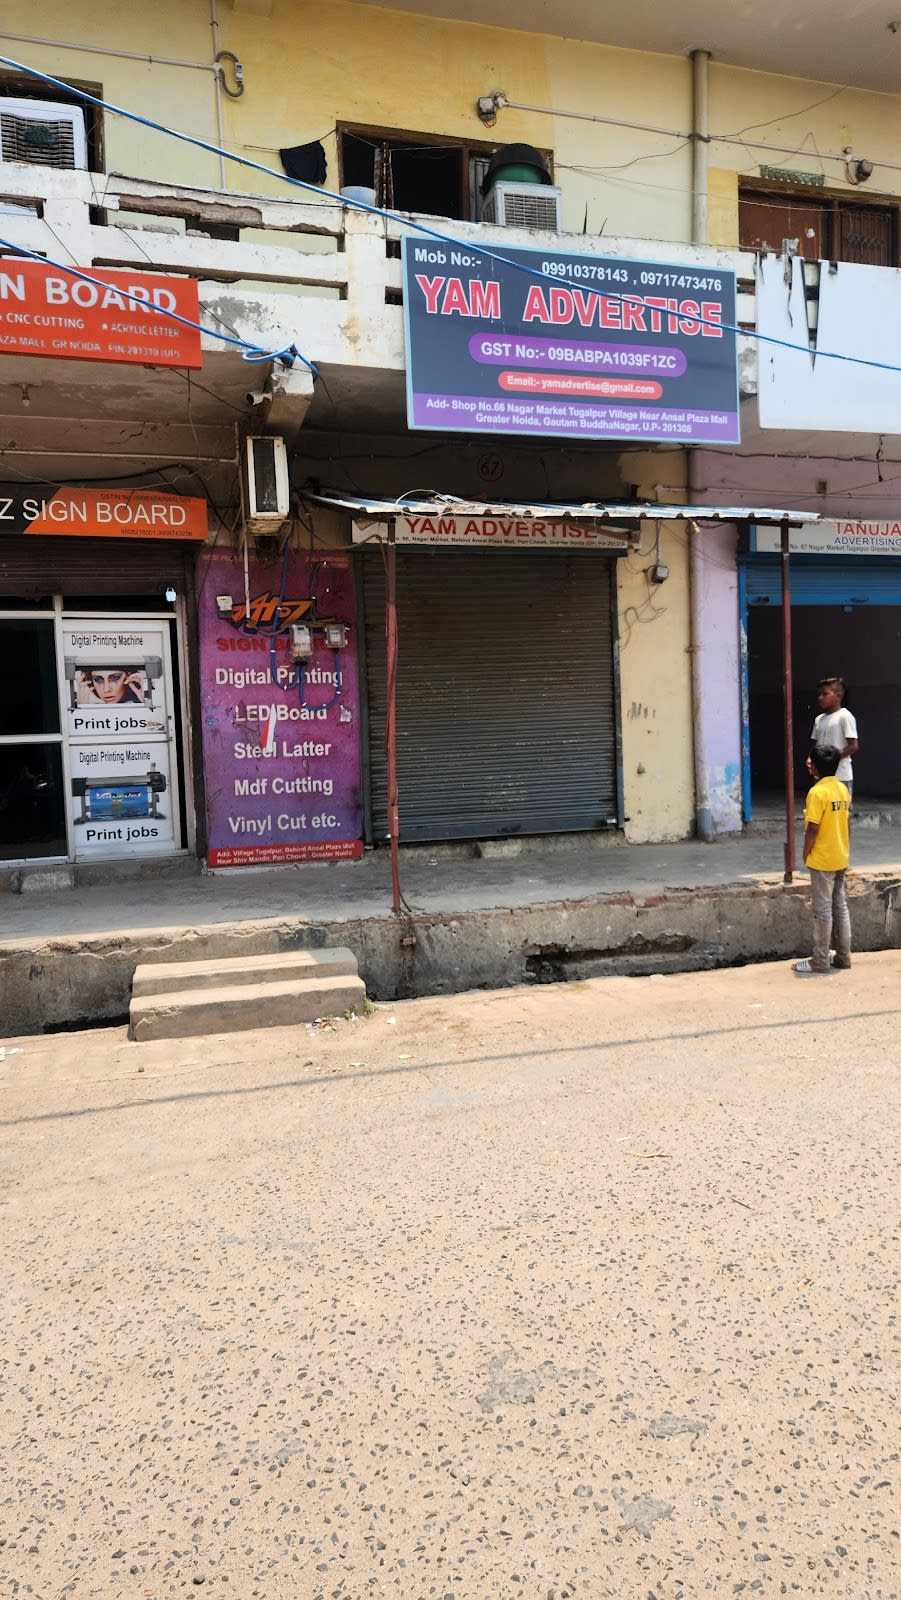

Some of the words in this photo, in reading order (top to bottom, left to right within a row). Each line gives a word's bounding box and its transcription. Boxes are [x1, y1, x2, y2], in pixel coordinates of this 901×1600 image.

[414, 248, 446, 263] Mob
[451, 252, 482, 267] No:-
[541, 261, 629, 282] 09910378143
[640, 271, 722, 291] 09717473476
[45, 277, 177, 315] BOARD
[414, 274, 501, 319] YAM
[522, 285, 723, 338] ADVERTISE
[6, 312, 31, 325] CNC
[34, 315, 85, 329] CUTTING
[111, 323, 146, 335] ACRYLIC
[149, 326, 180, 337] LETTER
[481, 342, 512, 357] GST
[516, 345, 545, 360] No:-
[548, 347, 676, 369] 09BABPA1039F1ZC
[507, 375, 540, 387] Email:-
[541, 379, 655, 394] yamadvertise@gmail.com
[426, 398, 450, 409] Add-
[451, 400, 477, 412] Shop
[478, 402, 505, 413] No.66
[507, 403, 534, 416] Nagar
[536, 405, 567, 416] Market
[569, 407, 606, 421] Tugalpur
[609, 409, 637, 421] Village
[639, 411, 660, 421] Near
[661, 412, 685, 422] Ansal
[687, 413, 709, 423] Plaza
[711, 415, 728, 424] Mall
[476, 413, 510, 424] Greater
[512, 414, 541, 426] Noida,
[543, 417, 578, 428] Gautam
[0, 498, 14, 520] Z
[22, 499, 87, 523] SIGN
[96, 502, 186, 526] BOARD
[405, 517, 456, 534] YAM
[835, 521, 901, 536] TANUJA
[834, 537, 901, 547] ADVERTISING
[71, 634, 91, 648] Digital
[92, 635, 117, 648] Printing
[118, 635, 143, 646] Machine
[216, 638, 267, 652] SIGN
[215, 668, 273, 688] Digital
[235, 704, 270, 721] LED
[277, 704, 327, 720] Board
[74, 718, 110, 730] Print
[115, 717, 147, 731] jobs
[79, 752, 99, 765] Digital
[100, 750, 124, 764] Printing
[125, 749, 150, 761] Machine
[234, 742, 276, 759] Steel
[283, 741, 332, 757] Latter
[234, 777, 268, 796] Mdf
[272, 776, 333, 796] Cutting
[228, 815, 272, 836] Vinyl
[277, 813, 307, 831] Cut
[311, 812, 341, 828] etc.
[86, 828, 122, 841] Print
[126, 826, 159, 841] jobs
[233, 848, 254, 857] Village
